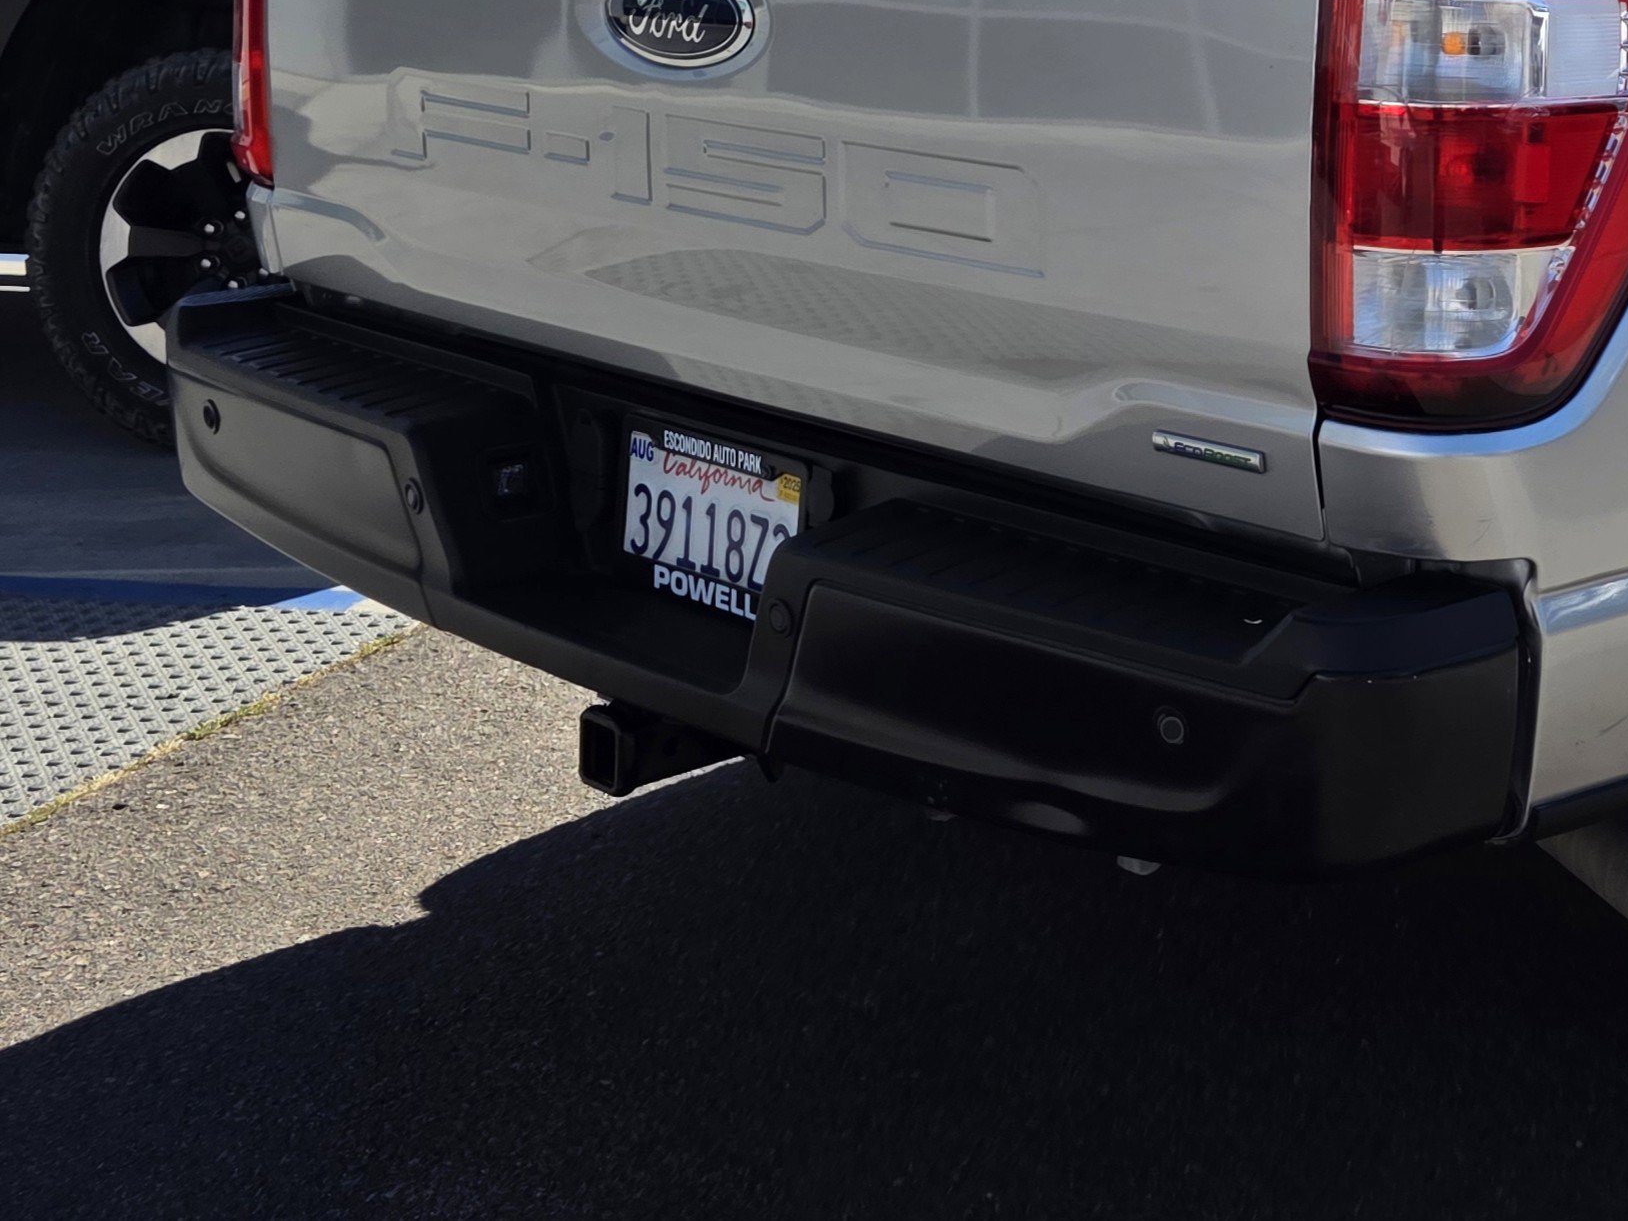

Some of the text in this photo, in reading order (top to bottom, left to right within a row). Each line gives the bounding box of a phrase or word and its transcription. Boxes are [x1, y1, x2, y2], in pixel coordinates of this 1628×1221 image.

[96, 98, 232, 156] WRAN
[391, 87, 1045, 277] F-150
[631, 436, 655, 462] AUG
[664, 430, 762, 475] ESCONDIDO AUTO PARK
[663, 451, 775, 502] California
[653, 564, 757, 621] POWELL
